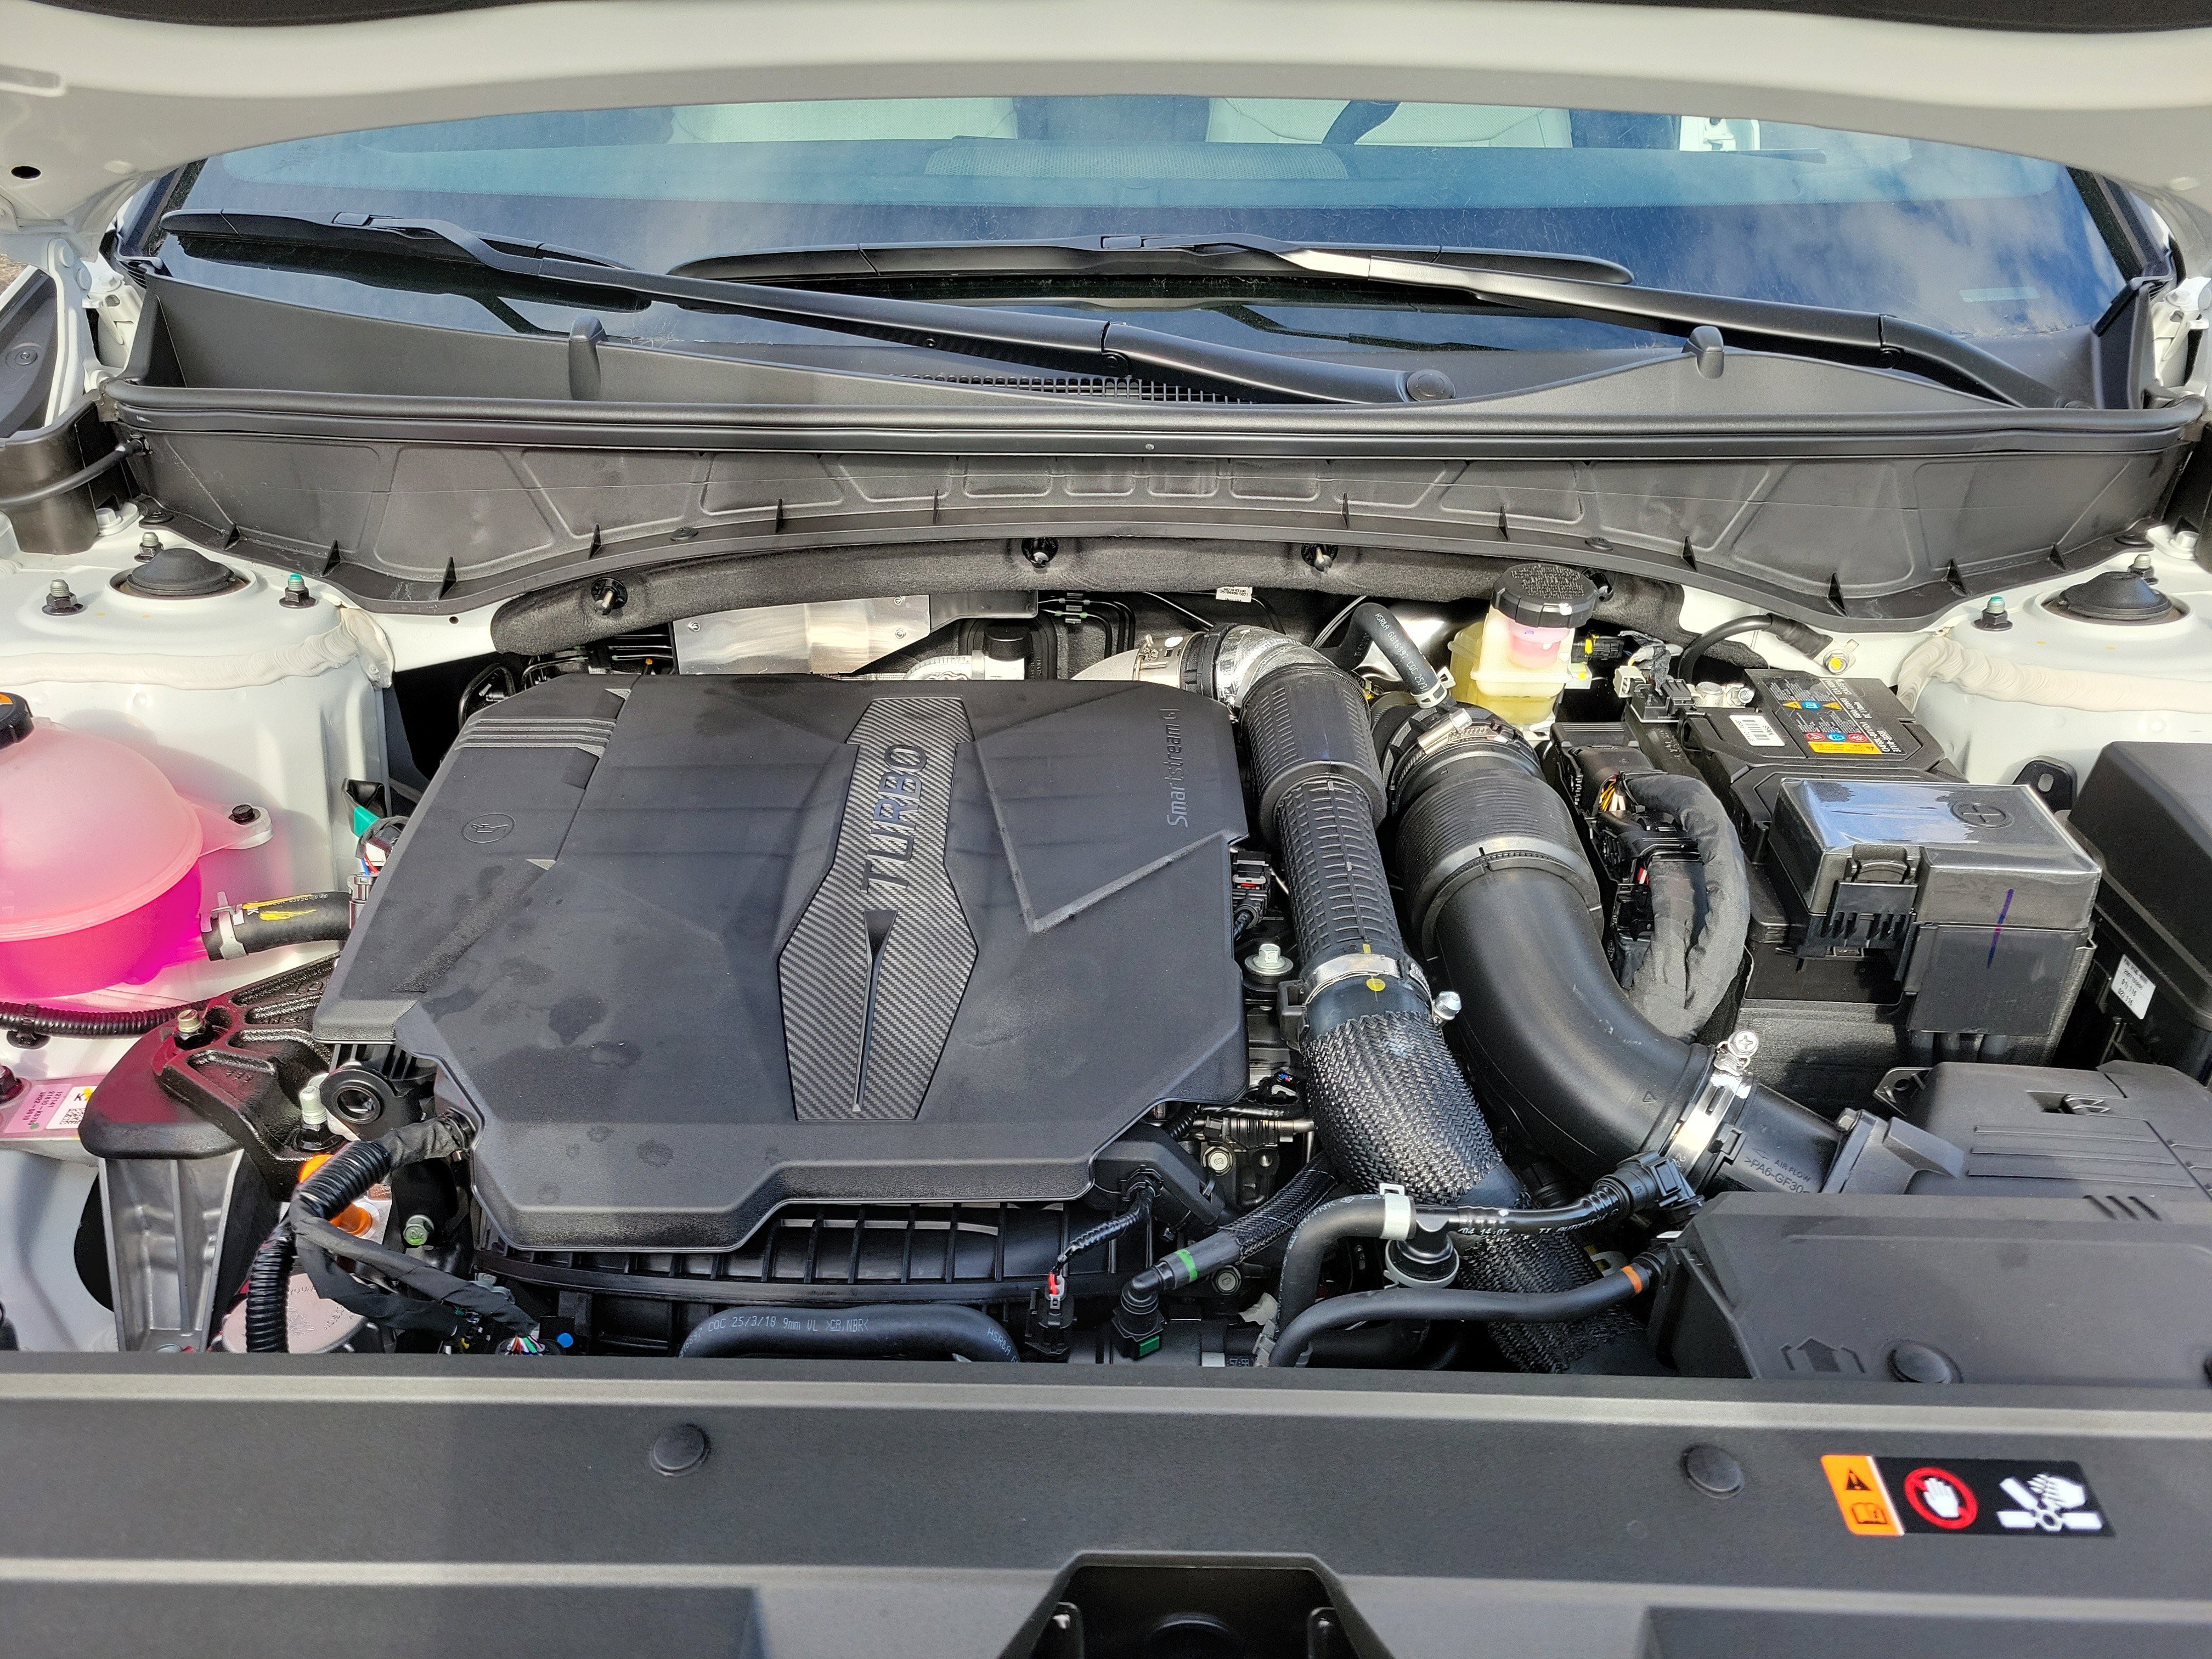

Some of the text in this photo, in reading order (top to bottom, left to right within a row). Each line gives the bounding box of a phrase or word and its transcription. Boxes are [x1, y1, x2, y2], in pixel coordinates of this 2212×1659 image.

[1387, 631, 1409, 659] GB16897
[1163, 723, 1188, 827] Smartstream
[861, 744, 927, 894] TURBO
[48, 1091, 63, 1107] 127141
[708, 1318, 726, 1332] CQC
[732, 1315, 776, 1327] 25/3/18
[783, 1317, 801, 1331] 9mm
